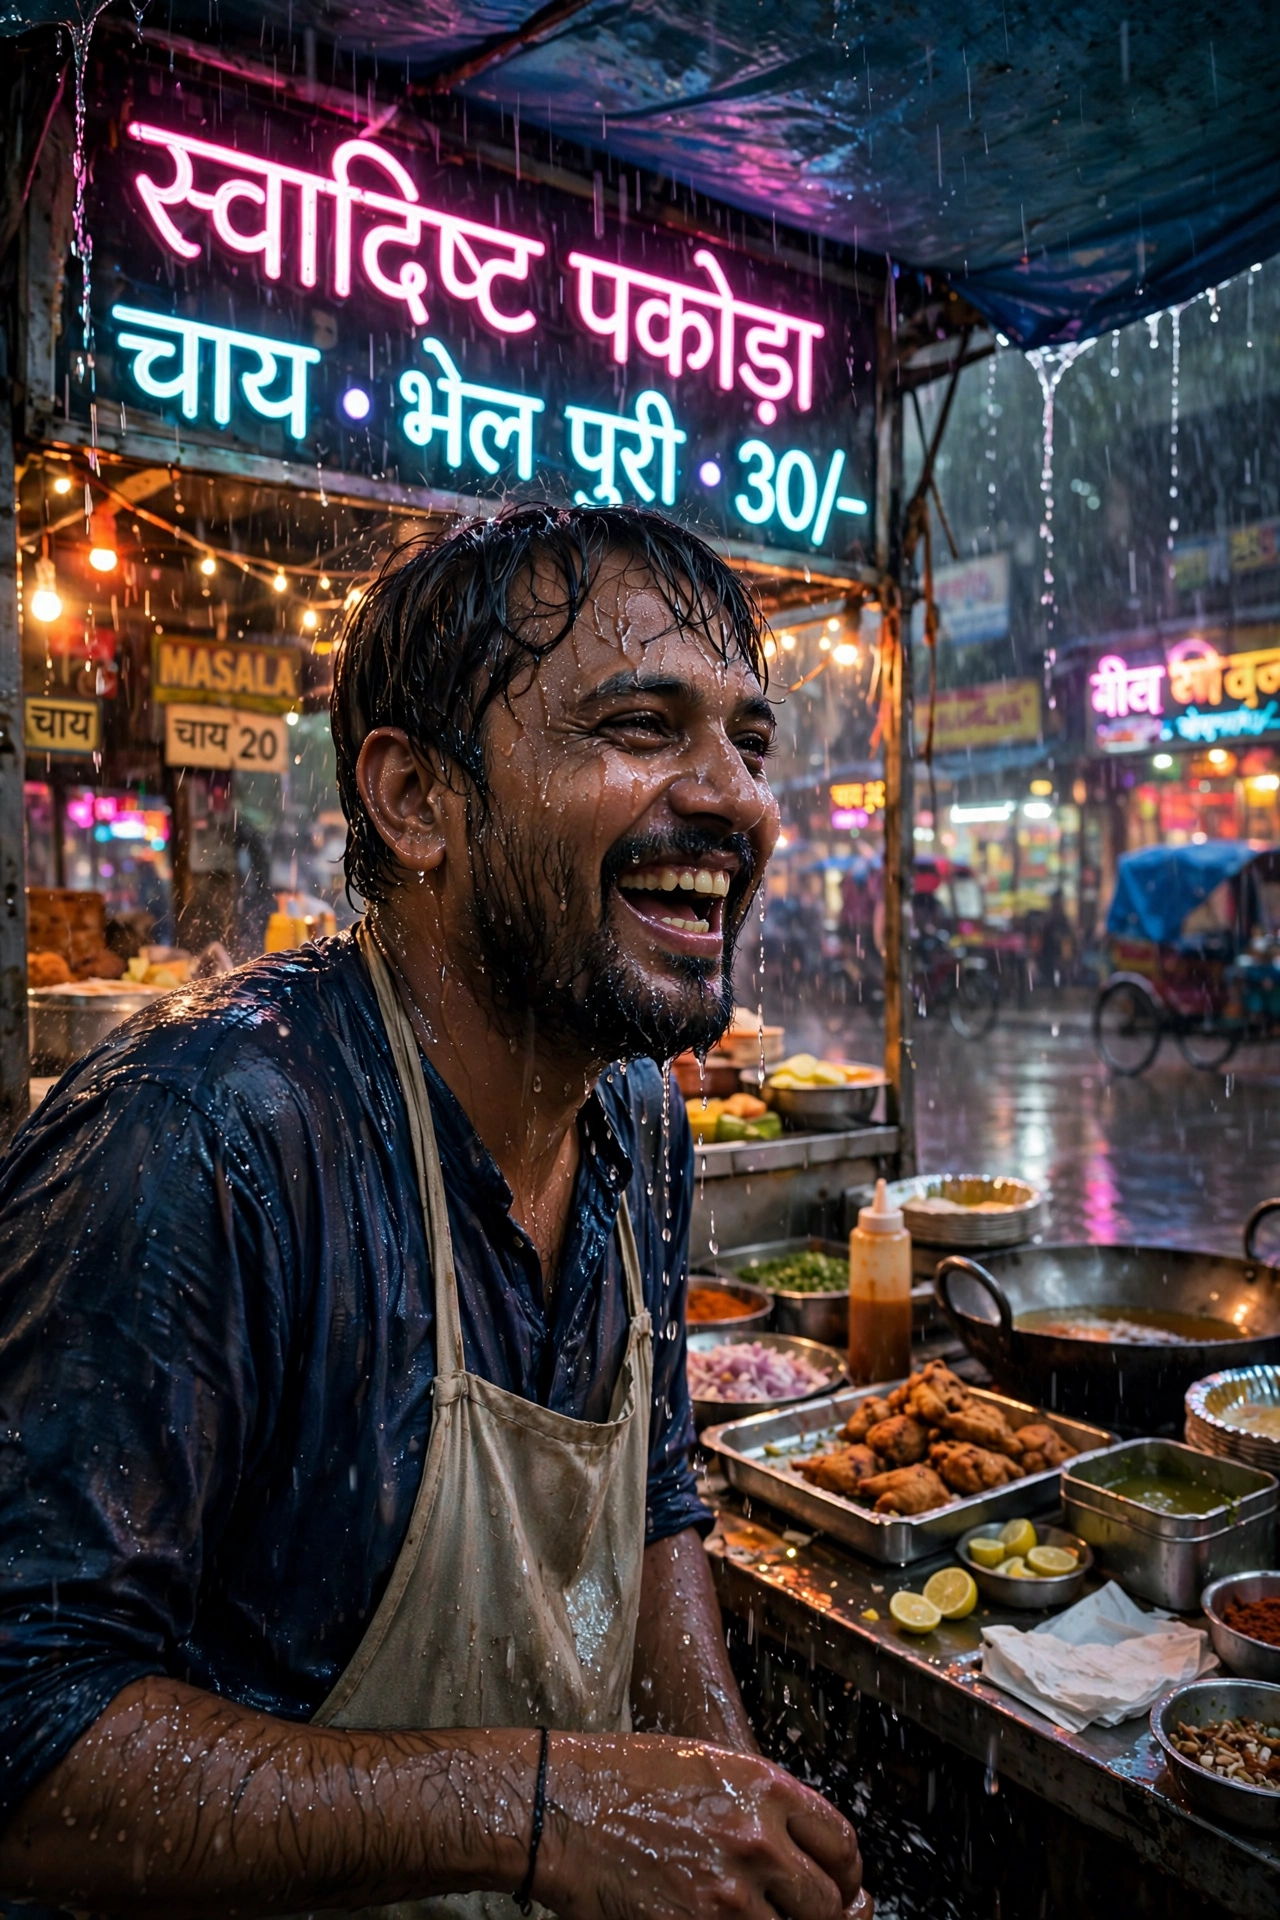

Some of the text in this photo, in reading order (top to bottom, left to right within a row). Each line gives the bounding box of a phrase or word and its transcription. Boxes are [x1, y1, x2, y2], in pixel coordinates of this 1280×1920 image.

[128, 121, 825, 425] स्वादिष्ट पकोड़ा
[112, 304, 868, 547] चाय भेल पुरी 30/-
[159, 642, 298, 698] MASALA
[31, 705, 93, 742] चाय
[174, 718, 278, 761] चाय 20
